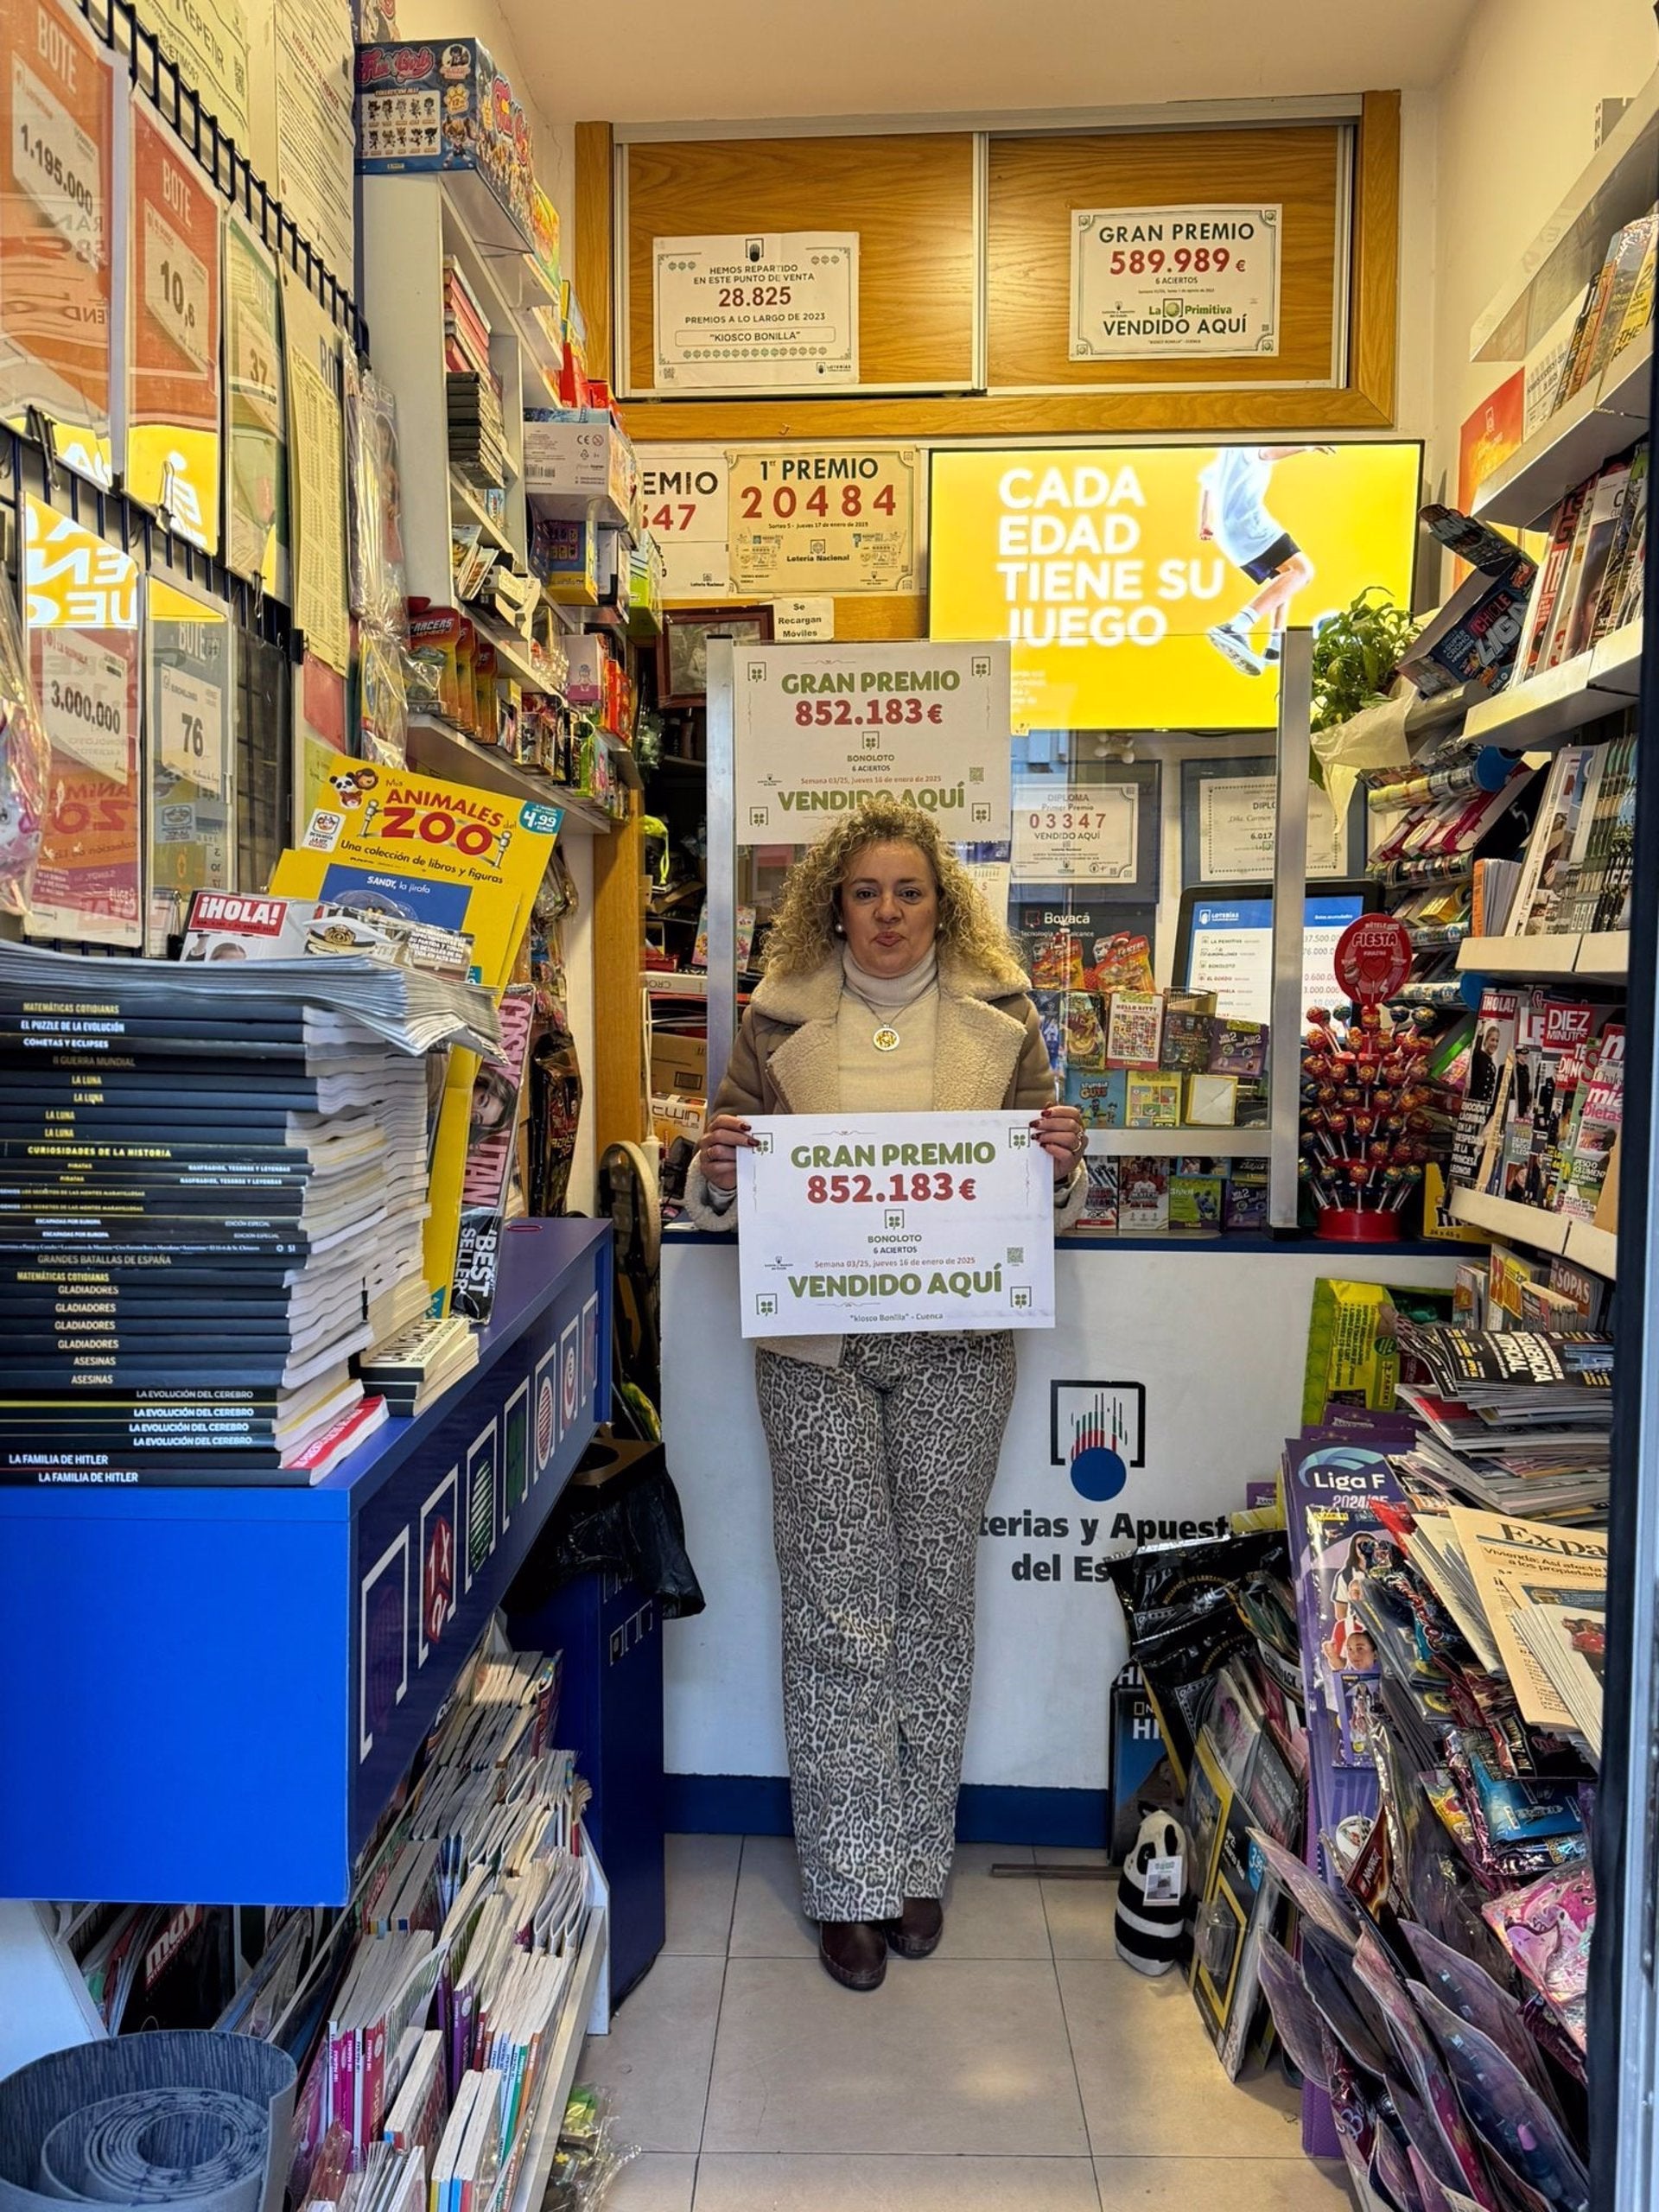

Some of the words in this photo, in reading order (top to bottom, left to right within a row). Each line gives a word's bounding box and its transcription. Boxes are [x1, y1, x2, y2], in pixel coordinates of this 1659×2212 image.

[37, 3, 79, 93] BOTE
[20, 124, 93, 216] 1.195.000
[162, 159, 193, 230] BOTE
[1099, 225, 1162, 243] GRAN
[1173, 223, 1254, 240] PREMIO
[745, 264, 798, 273] REPARTIDO
[1110, 248, 1230, 275] 589.989
[1236, 259, 1246, 272] €
[719, 287, 791, 308] 28.825
[1149, 306, 1161, 315] La
[1185, 305, 1232, 315] Primitiva
[1103, 319, 1189, 335] VENDIDO
[1198, 314, 1246, 334] AQUÍ
[710, 334, 752, 342] "KIOSCO
[754, 332, 800, 340] BONILLA"
[783, 458, 878, 480] PREMIO
[997, 466, 1145, 509] CADA
[998, 514, 1141, 556] EDAD
[996, 560, 1144, 601] TIENE
[1157, 558, 1225, 600] SU
[1006, 606, 1167, 648] JUEGO
[179, 622, 207, 661] BOTE
[781, 672, 855, 694] GRAN
[861, 670, 960, 692] PREMIO
[51, 680, 121, 734] 3.000.000
[795, 698, 923, 726] 852.183
[927, 703, 943, 724] €
[181, 713, 204, 757] 76
[901, 781, 964, 812] AQUÍ
[386, 789, 504, 828] ANIMALES
[503, 820, 517, 830] del
[524, 810, 556, 828] 4,99
[380, 806, 493, 856] ZOO
[1029, 813, 1106, 829] 03347
[1077, 832, 1100, 841] AQUÍ
[340, 840, 362, 851] Una
[364, 845, 410, 861] colección
[412, 855, 425, 867] de
[429, 859, 456, 875] libros
[459, 868, 467, 877] y
[468, 867, 503, 884] figuras
[367, 875, 396, 890] SANDY,
[398, 881, 407, 890] la
[409, 883, 431, 893] jirafa
[199, 896, 281, 925] ¡HOLA!
[1045, 912, 1090, 925] Boyacá
[1352, 932, 1397, 947] FIESTA
[23, 1001, 73, 1014] MATEMÁTICAS
[75, 1004, 119, 1014] COTIDIANAS
[1482, 996, 1516, 1013] ¡HOLA!
[21, 1020, 30, 1031] EL
[32, 1020, 59, 1031] PUZZLE
[60, 1021, 69, 1032] DE
[71, 1021, 81, 1032] LA
[83, 1020, 124, 1033] EVOLUCIÓN
[1548, 1009, 1590, 1033] DIEZ
[23, 1039, 62, 1047] COMETAS
[63, 1039, 70, 1048] Y
[71, 1039, 109, 1048] ECLIPSES
[28, 1146, 96, 1156] CURIOSIDADES
[98, 1147, 111, 1156] DE
[112, 1148, 125, 1157] LA
[128, 1147, 171, 1158] HISTORIA
[791, 1145, 875, 1168] GRAN
[882, 1141, 995, 1166] PREMIO
[807, 1173, 953, 1204] 852.183
[959, 1178, 976, 1201] €
[868, 1234, 922, 1243] BONOLOTO
[37, 1255, 79, 1265] GRANDES
[80, 1255, 123, 1265] BATALLAS
[124, 1255, 137, 1265] DE
[137, 1254, 171, 1265] ESPAÑA
[454, 1227, 477, 1292] SELLER
[847, 1260, 871, 1268] 03/25,
[873, 1260, 898, 1268] jueves
[58, 1285, 119, 1295] GLADIADORES
[788, 1273, 922, 1298] VENDIDO
[927, 1262, 1001, 1298] AQUÍ
[1556, 1268, 1590, 1304] SOPAS
[55, 1303, 116, 1313] GLADIADORES
[54, 1320, 116, 1331] GLADIADORES
[73, 1356, 116, 1366] ASESINAS
[71, 1375, 113, 1384] ASESINAS
[137, 1390, 144, 1399] LA
[146, 1389, 194, 1399] EVOLUCIÓN
[196, 1389, 213, 1399] DEL
[214, 1389, 253, 1399] CEREBRO
[9, 1454, 20, 1465] LA
[22, 1454, 59, 1465] FAMILIA
[60, 1455, 73, 1465] DE
[74, 1455, 108, 1465] HITLER
[39, 1471, 50, 1483] LA
[52, 1471, 88, 1483] FAMILIA
[90, 1472, 104, 1483] DE
[105, 1472, 138, 1483] HITLER
[1313, 1472, 1366, 1491] Liga
[1371, 1474, 1385, 1489] F
[1080, 1517, 1099, 1547] y
[1497, 1522, 1607, 1556] Expa
[1484, 1547, 1540, 1564] Vivienda:
[1011, 1554, 1061, 1582] del
